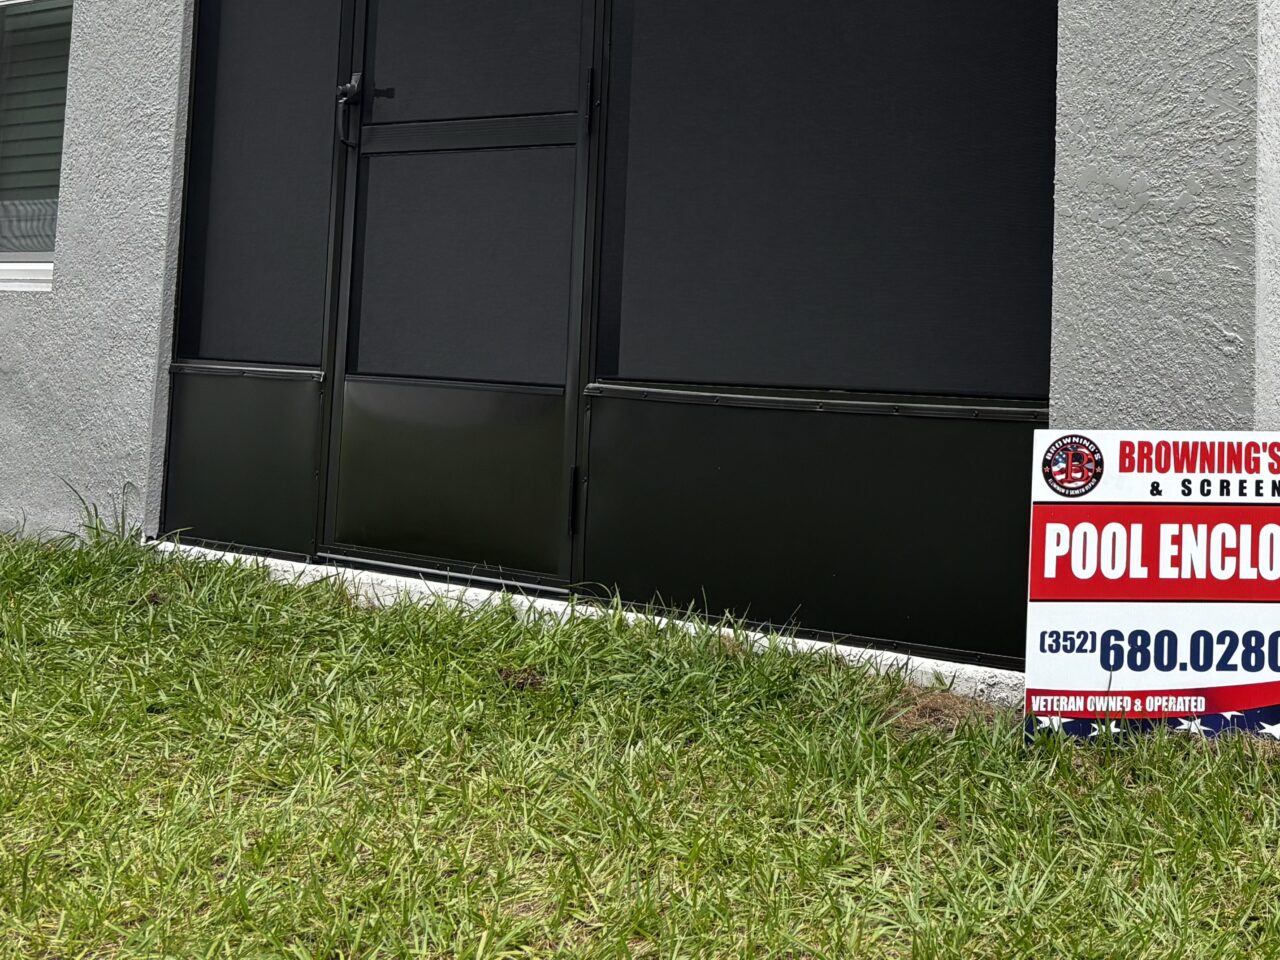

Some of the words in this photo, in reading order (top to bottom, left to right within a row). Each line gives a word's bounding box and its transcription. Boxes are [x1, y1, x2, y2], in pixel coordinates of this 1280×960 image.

[1045, 437, 1101, 460] BROWNING'S
[1149, 481, 1163, 497] &
[1043, 522, 1149, 581] POOL
[1039, 631, 1097, 654] (352)
[1031, 695, 1084, 712] VETERAN
[1087, 696, 1132, 713] OWNED
[1133, 697, 1143, 712] &
[1145, 696, 1206, 712] OPERATED
